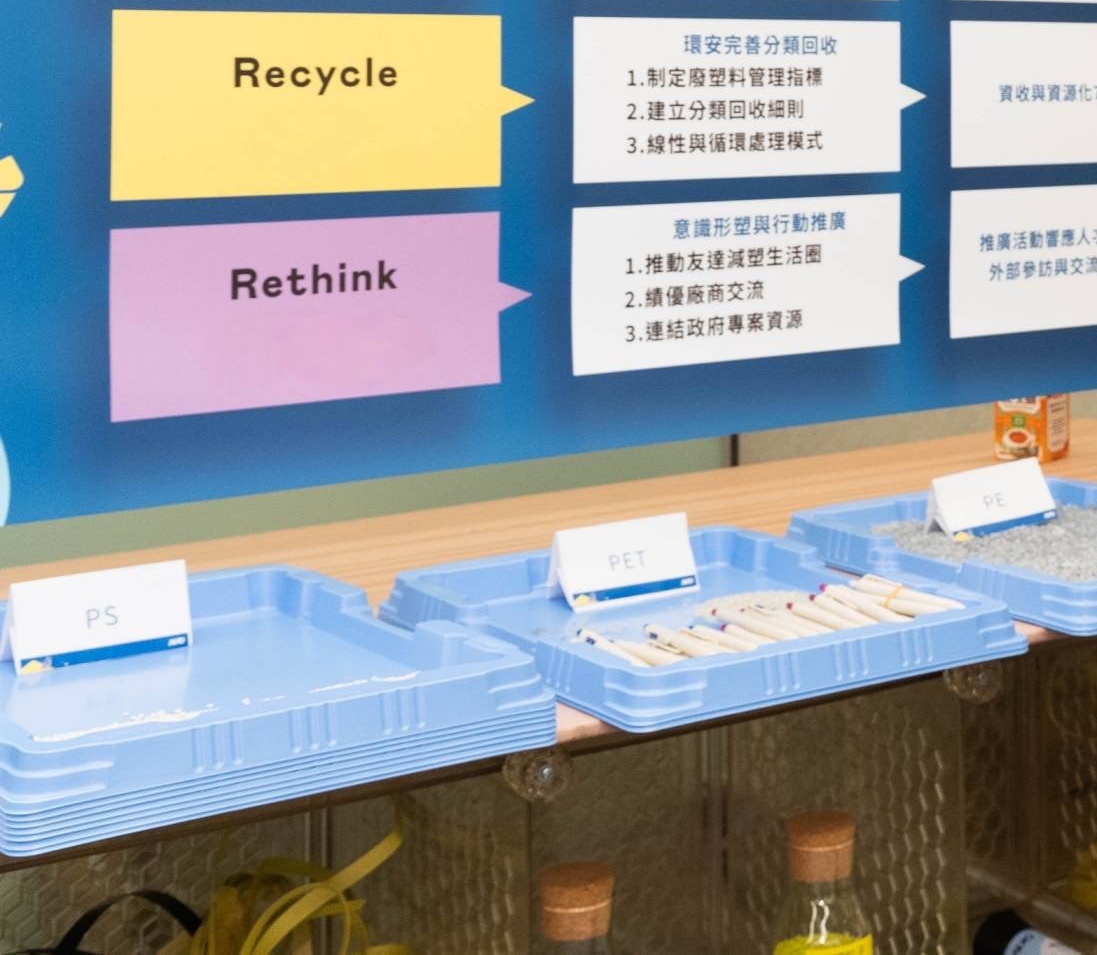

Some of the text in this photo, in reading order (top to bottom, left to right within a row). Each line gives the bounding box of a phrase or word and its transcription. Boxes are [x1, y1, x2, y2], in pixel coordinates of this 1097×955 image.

[683, 34, 838, 56] 環安完善分類回收
[233, 56, 398, 96] Recycle
[627, 67, 823, 89] 1.制定廢塑料管理指標
[626, 99, 804, 122] 2.建立分類回收細則
[626, 131, 823, 155] 3.線性與循環處理模式
[673, 211, 846, 240] 意識形塑與行動推廣
[625, 244, 822, 276] 1.推動友達減塑生活圈
[230, 260, 398, 301] Rethink
[625, 280, 765, 309] 2.績優廠商交流
[625, 309, 804, 343] 3.連結政府專案資源
[983, 492, 1007, 509] PE
[608, 550, 646, 571] PET
[86, 605, 119, 628] PS
